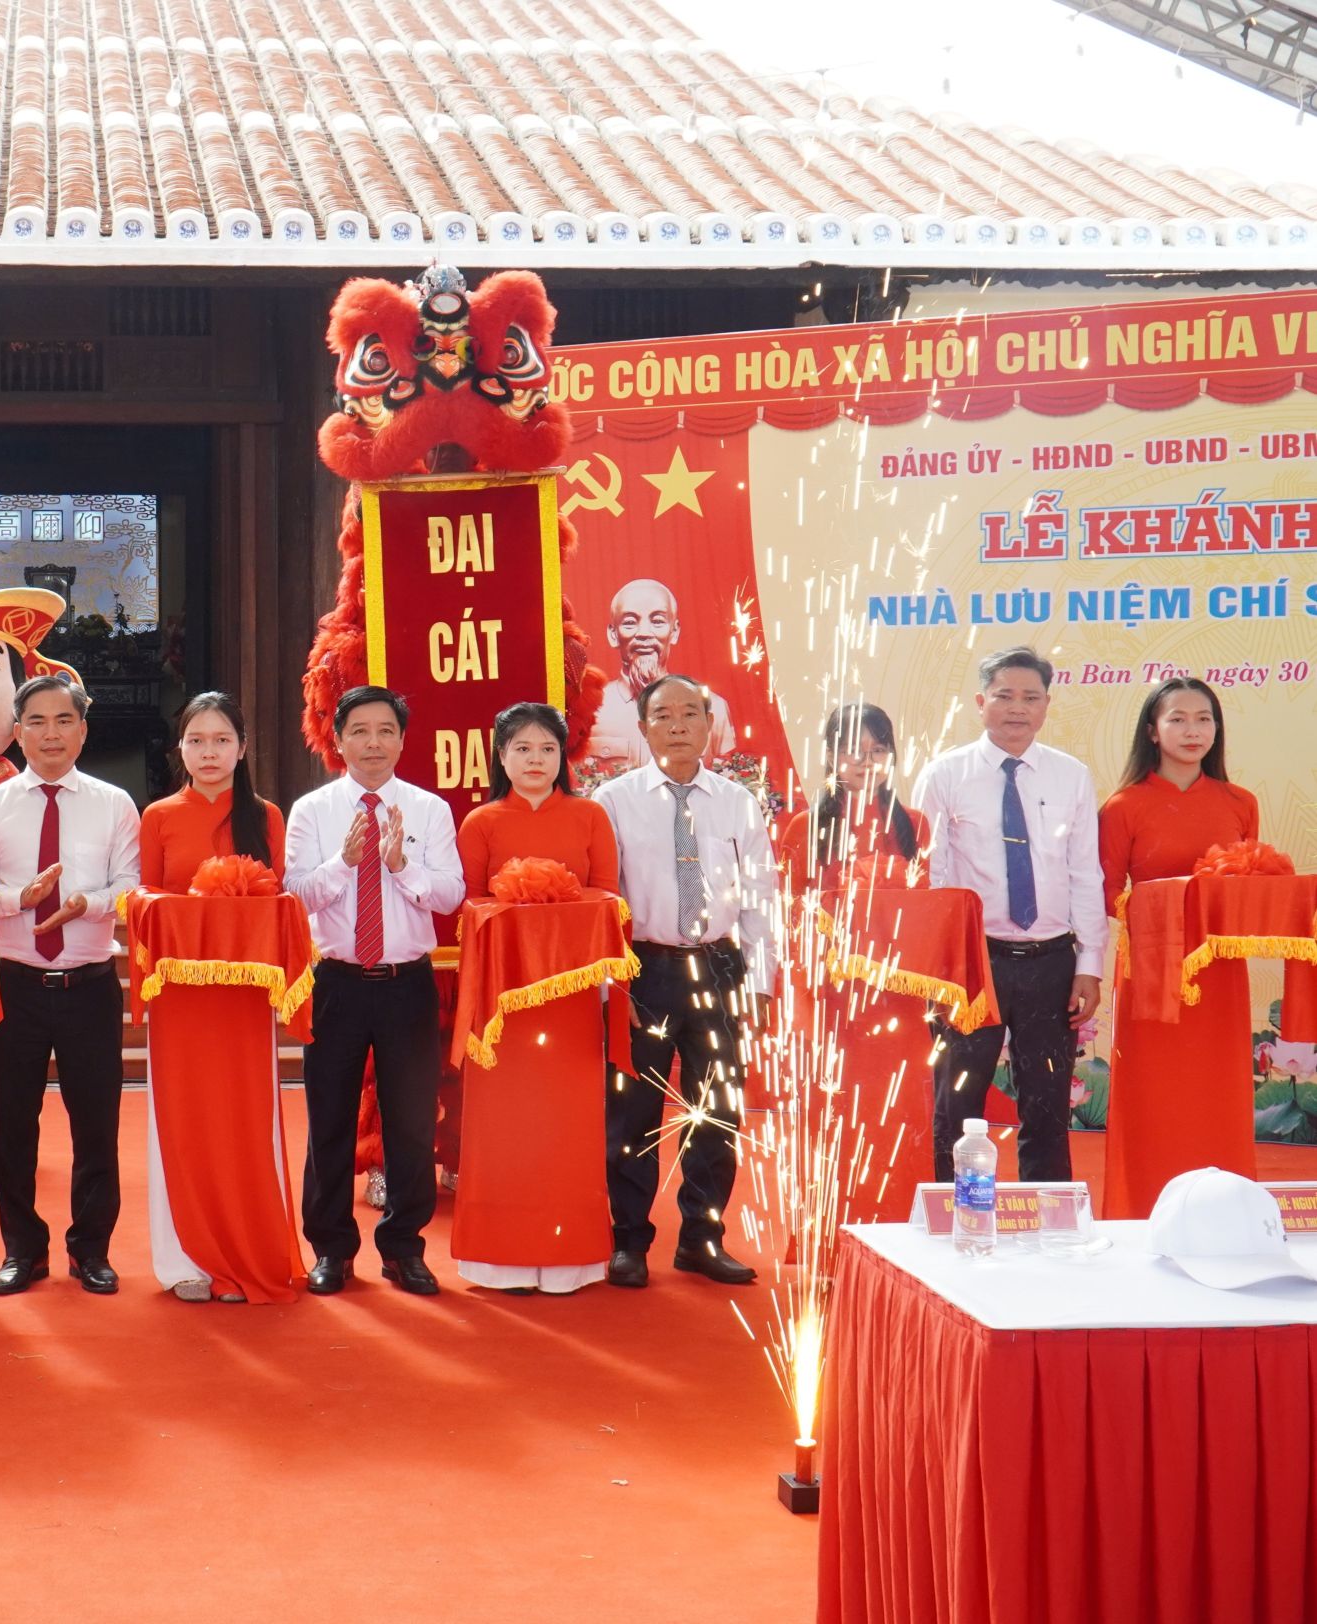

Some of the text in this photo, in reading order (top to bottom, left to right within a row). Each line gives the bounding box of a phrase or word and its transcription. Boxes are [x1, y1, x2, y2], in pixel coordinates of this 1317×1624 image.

[609, 351, 720, 406] CỘNG
[736, 341, 820, 391] HÒA
[832, 334, 892, 385] XÃ
[905, 330, 979, 387] HỘI
[996, 315, 1089, 374] CHỦ
[1106, 309, 1258, 366] NGHĨA
[881, 447, 957, 478] ĐẢNG
[968, 443, 1002, 474] ỦY
[1032, 443, 1113, 471] HĐND
[1145, 437, 1228, 465] UBND
[427, 513, 495, 586] ĐẠI
[982, 490, 1317, 561] LỄ KHÁNH
[869, 588, 957, 626] NHÀ
[971, 587, 1051, 624] LƯU
[1068, 582, 1190, 627] NIỆM
[1208, 577, 1289, 619] CHÍ
[429, 608, 502, 683] CÁT
[1080, 664, 1131, 684] Bàn
[1206, 661, 1269, 687] ngày
[1278, 661, 1309, 683] 30
